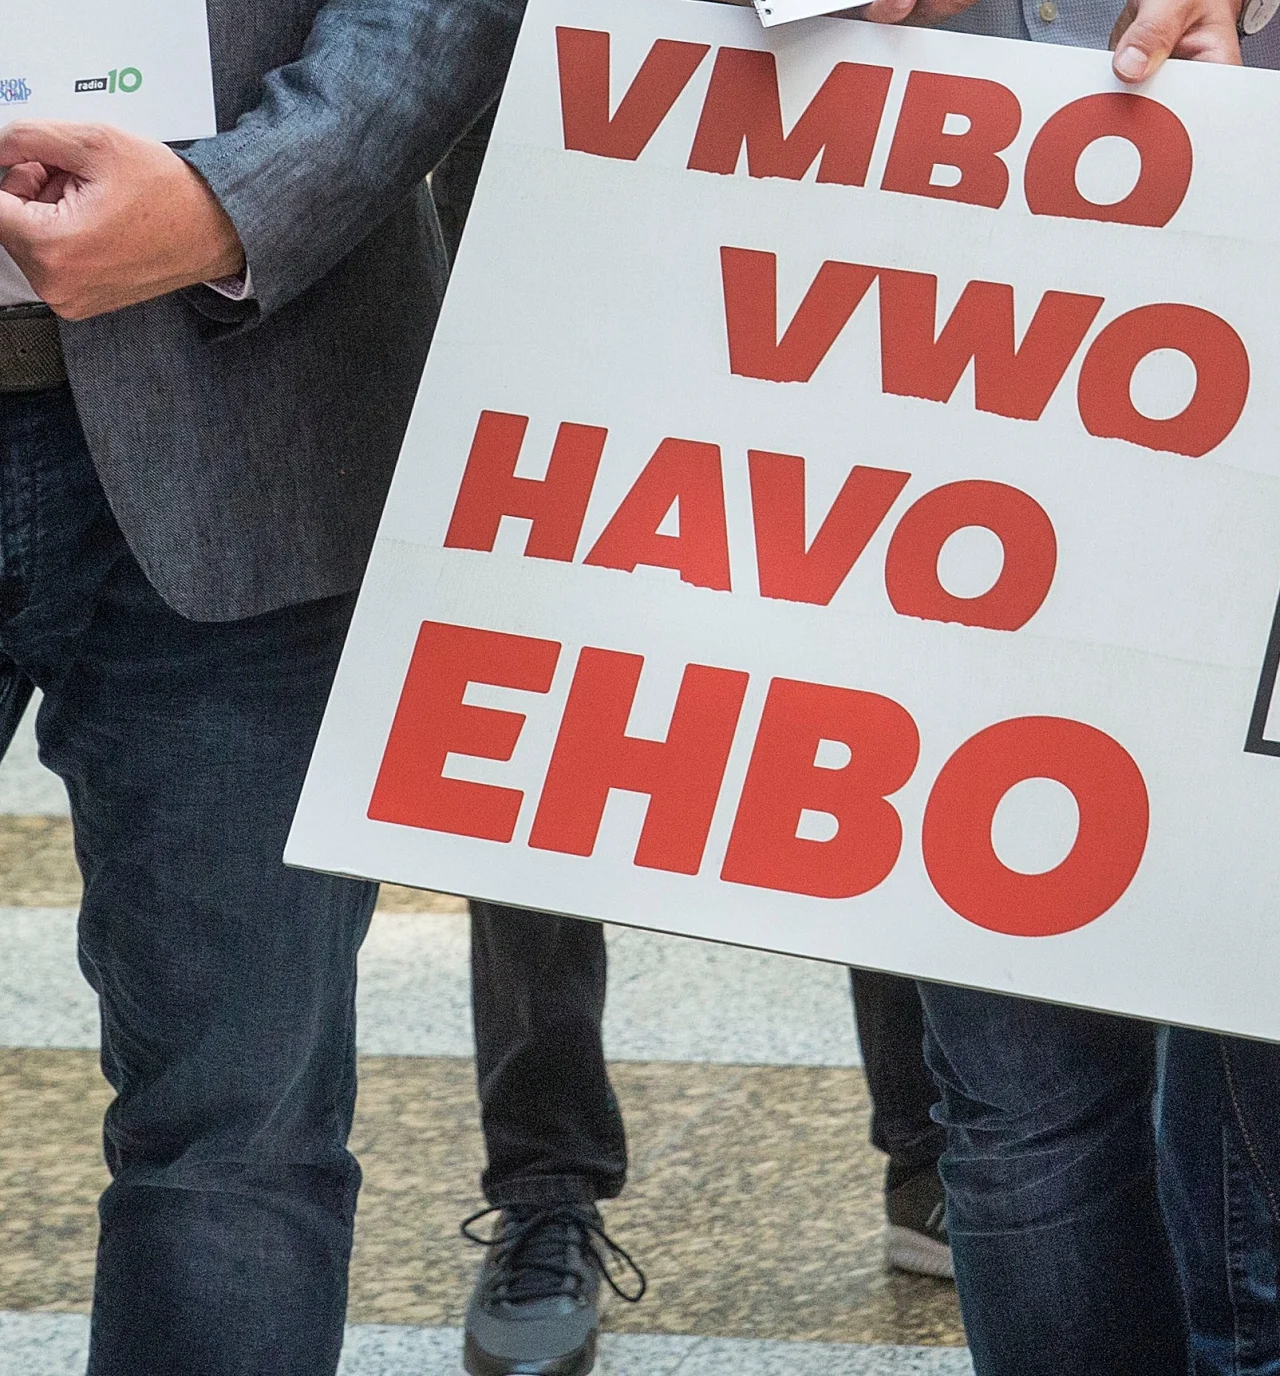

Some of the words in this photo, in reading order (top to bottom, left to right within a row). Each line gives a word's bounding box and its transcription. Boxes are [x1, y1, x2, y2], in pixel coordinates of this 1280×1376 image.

[77, 80, 104, 91] radio
[108, 66, 143, 94] 10
[554, 26, 1193, 227] VMBO
[719, 246, 1250, 458] VWO
[443, 409, 1058, 632] HAVO
[367, 620, 1150, 936] EHBO
